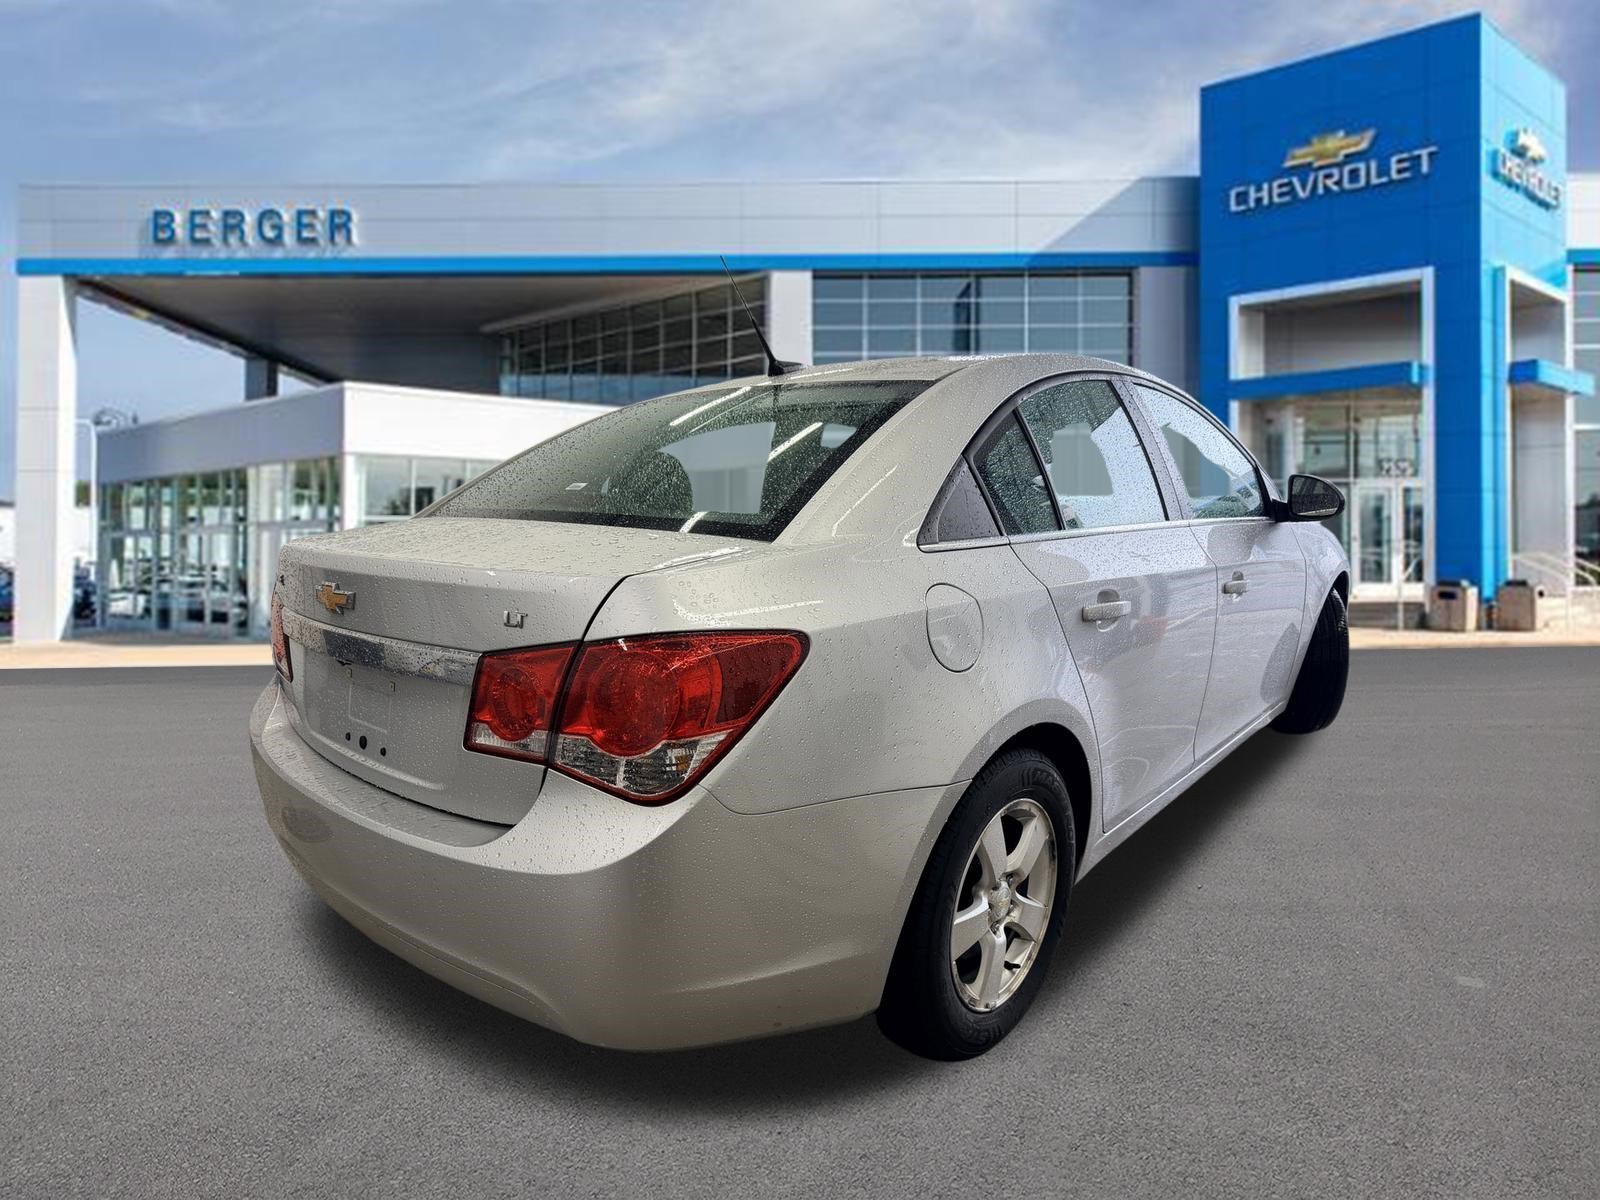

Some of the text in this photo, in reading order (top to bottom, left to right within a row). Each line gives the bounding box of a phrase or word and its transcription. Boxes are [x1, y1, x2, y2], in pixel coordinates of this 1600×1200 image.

[1229, 146, 1438, 213] CHEVROLET
[152, 208, 356, 246] BERGER
[503, 610, 528, 629] LT
